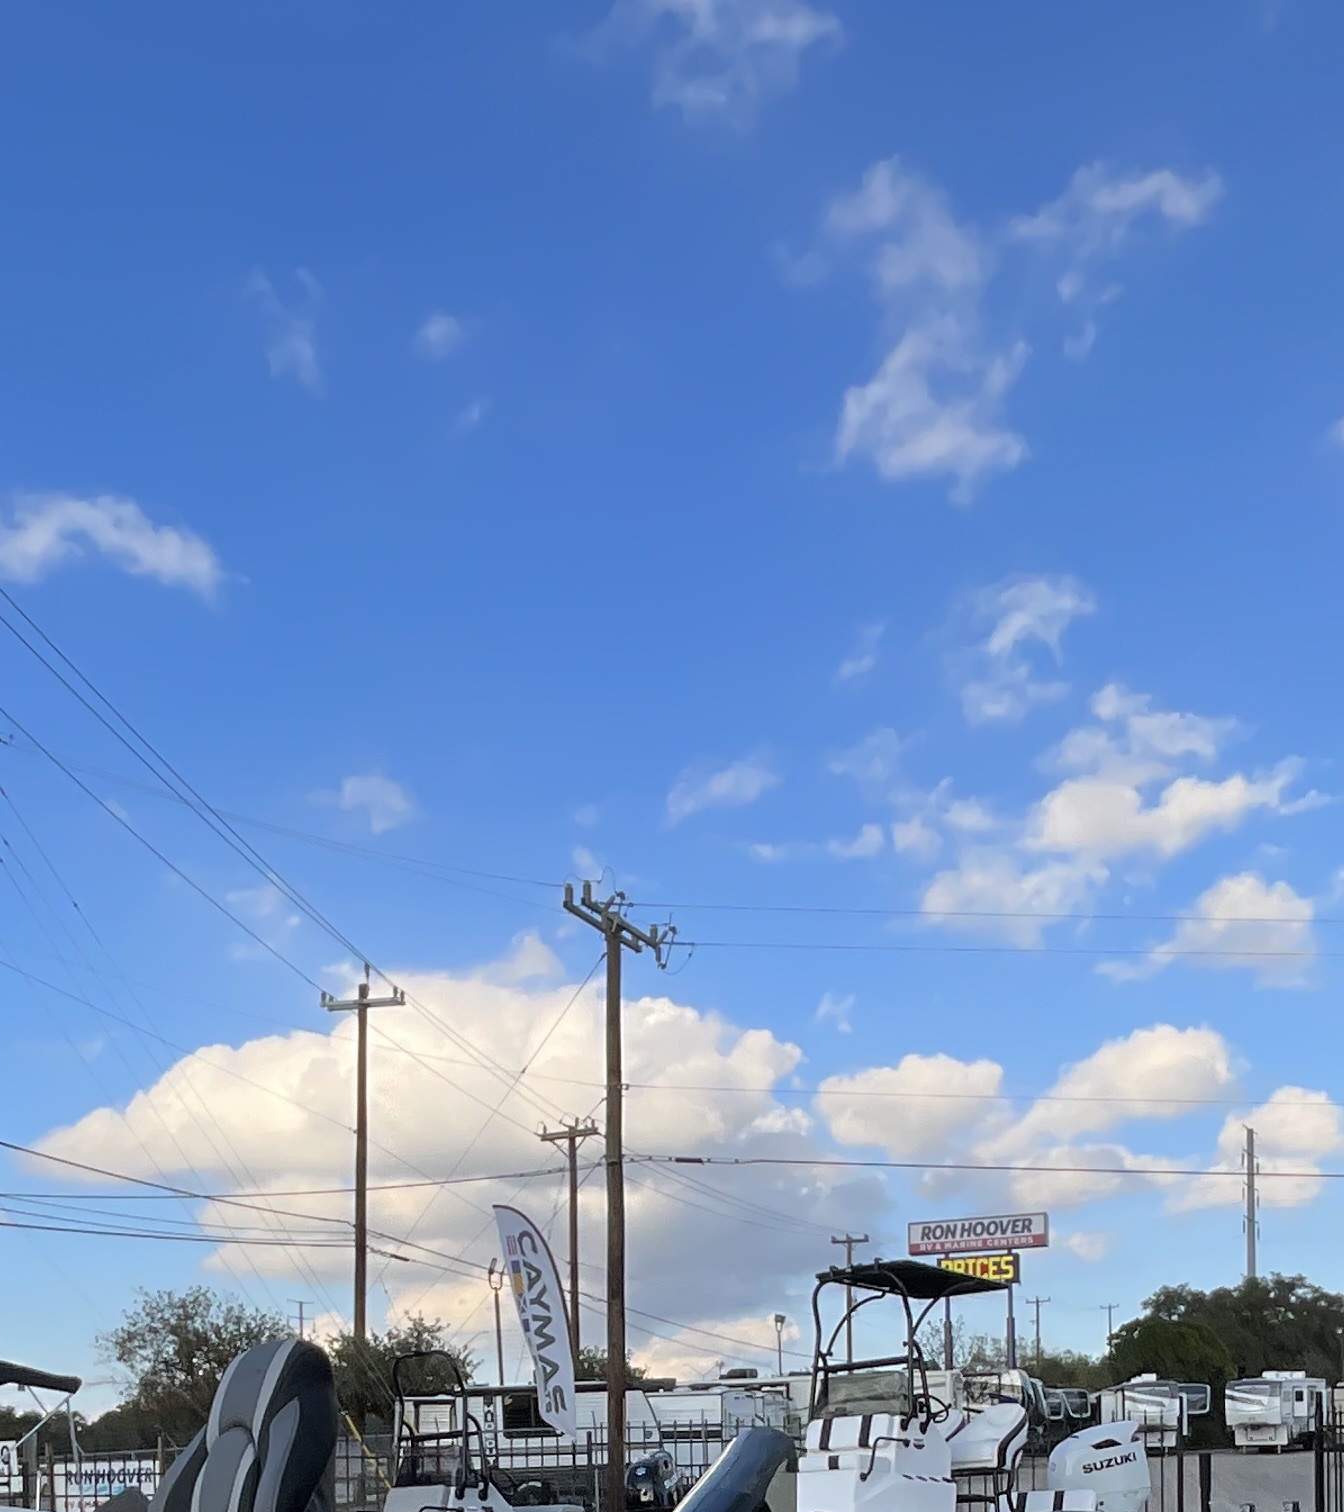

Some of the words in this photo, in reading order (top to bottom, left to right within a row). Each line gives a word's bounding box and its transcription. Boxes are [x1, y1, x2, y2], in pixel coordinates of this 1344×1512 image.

[921, 1223, 956, 1241] RON
[959, 1218, 1033, 1238] HOOVER
[944, 1238, 984, 1250] MARINE
[986, 1236, 1034, 1247] CENTERS
[517, 1229, 567, 1414] CAYMAS
[1082, 1452, 1138, 1475] SUZUKI
